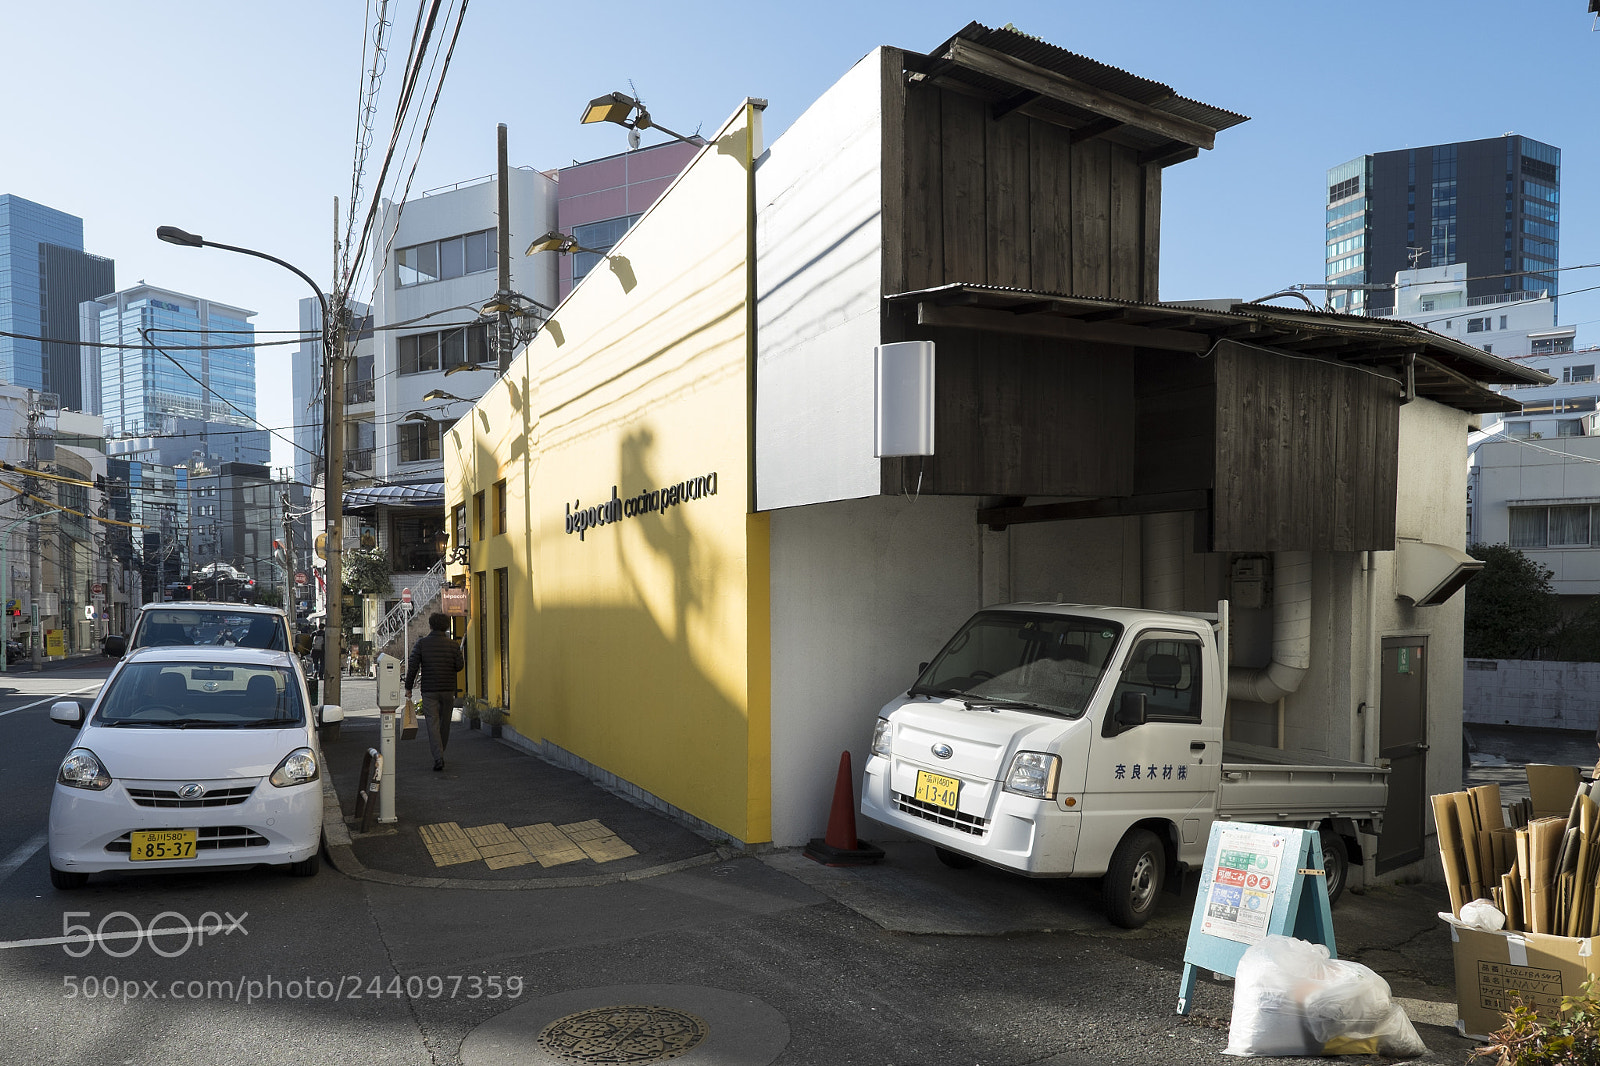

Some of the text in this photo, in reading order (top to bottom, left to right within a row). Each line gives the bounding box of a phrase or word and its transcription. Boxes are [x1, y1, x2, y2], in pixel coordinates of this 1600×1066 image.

[565, 472, 718, 541] bépocah cocina peruana
[925, 784, 956, 807] 13-40
[145, 842, 193, 857] 85-37
[1482, 987, 1502, 996] サイズ
